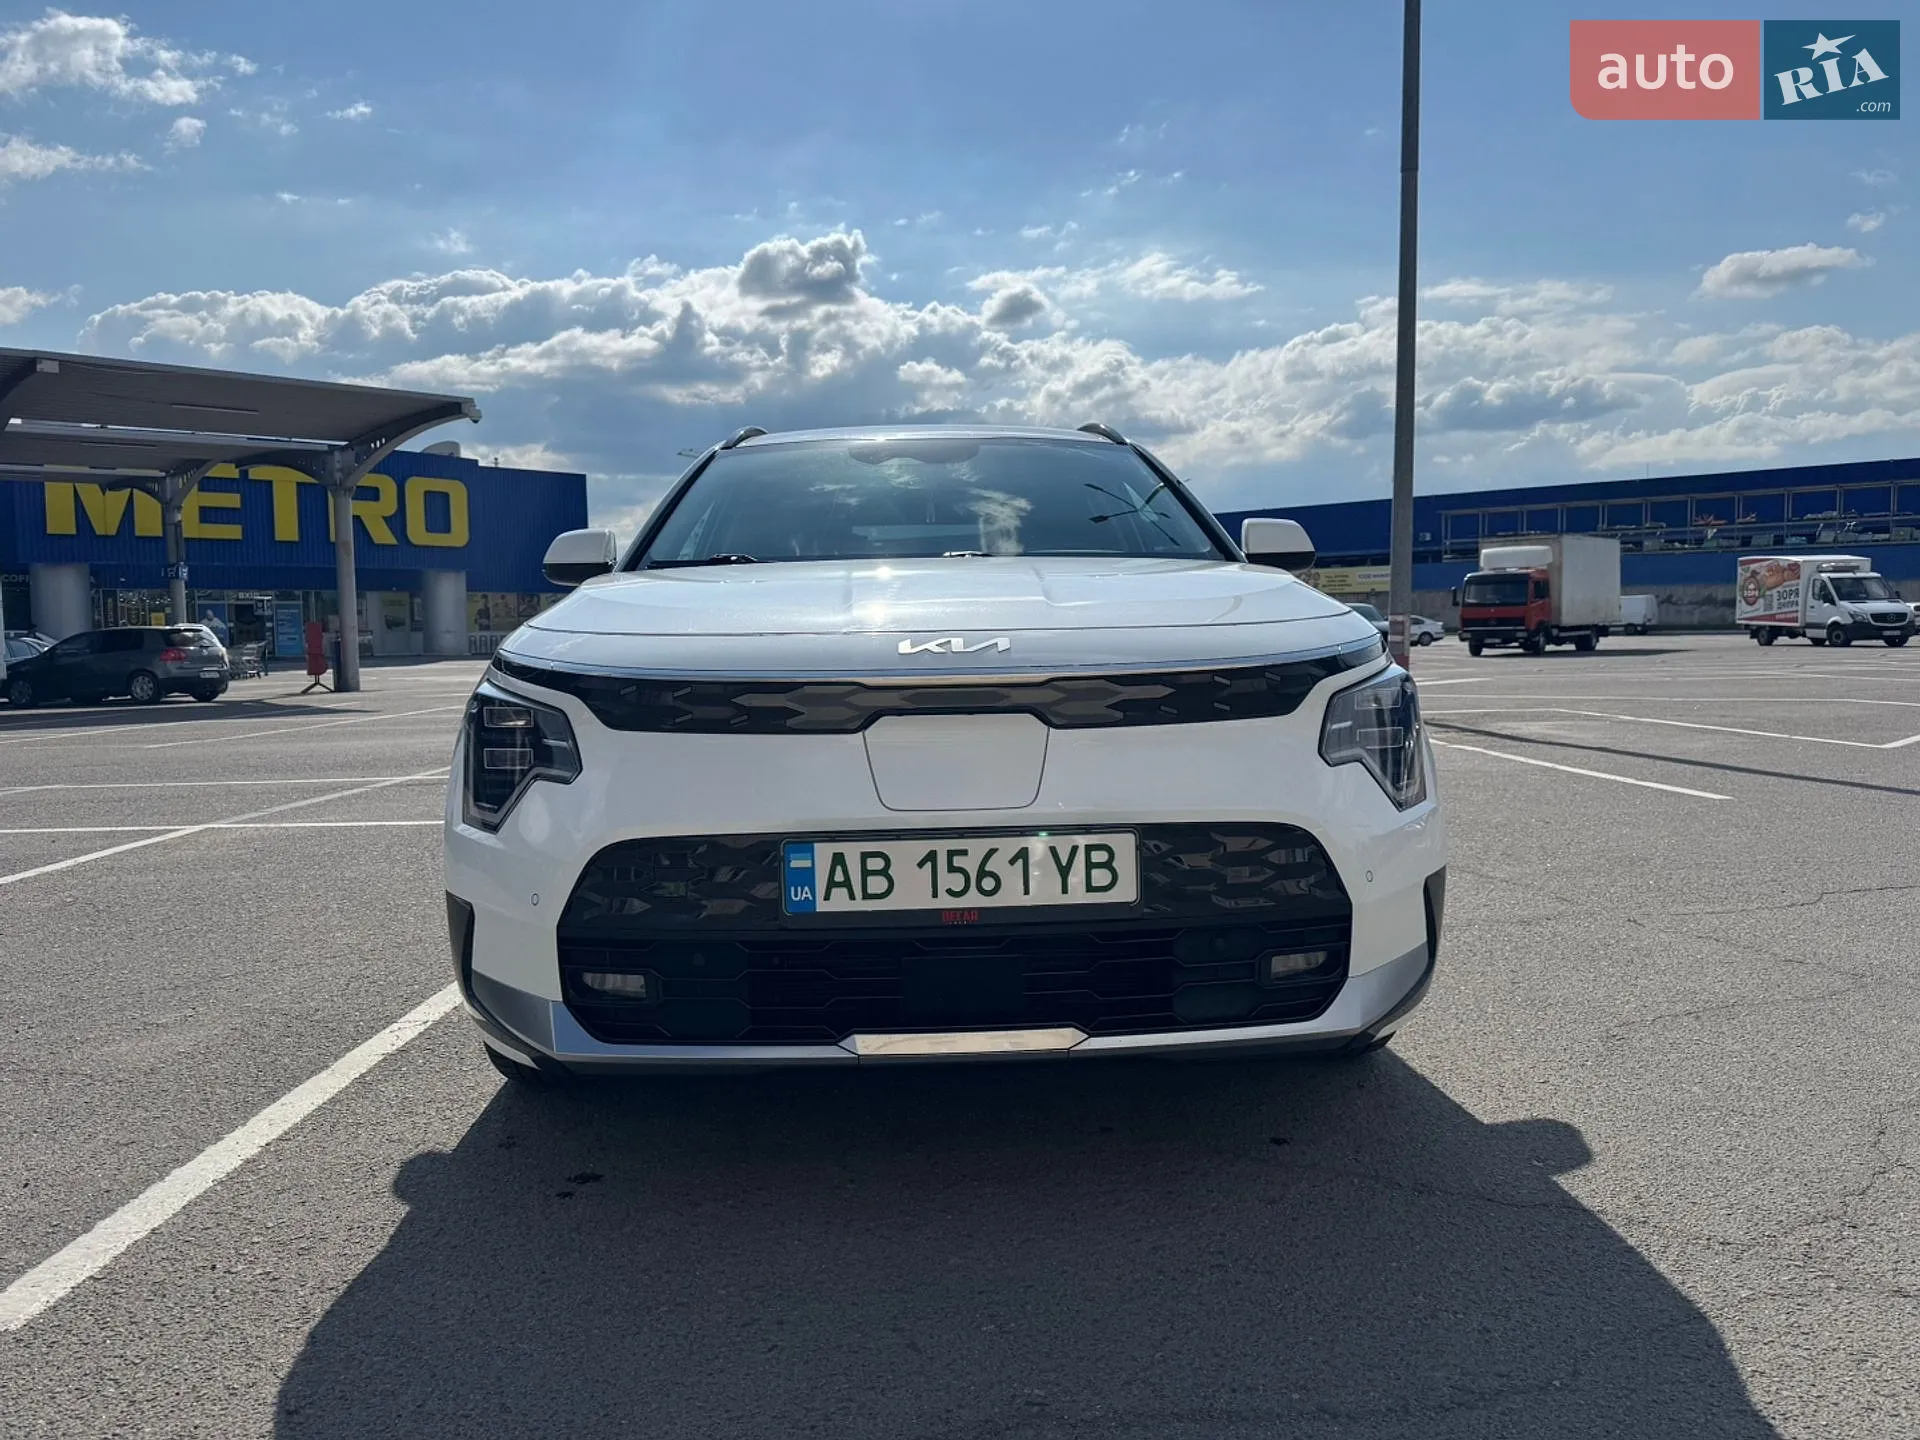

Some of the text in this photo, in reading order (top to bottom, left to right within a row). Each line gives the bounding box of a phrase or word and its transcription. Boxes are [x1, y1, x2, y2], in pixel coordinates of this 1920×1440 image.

[44, 464, 470, 548] METRO
[898, 637, 1011, 654] KIA
[823, 843, 1118, 901] AB 1561 YB
[790, 886, 812, 901] UA
